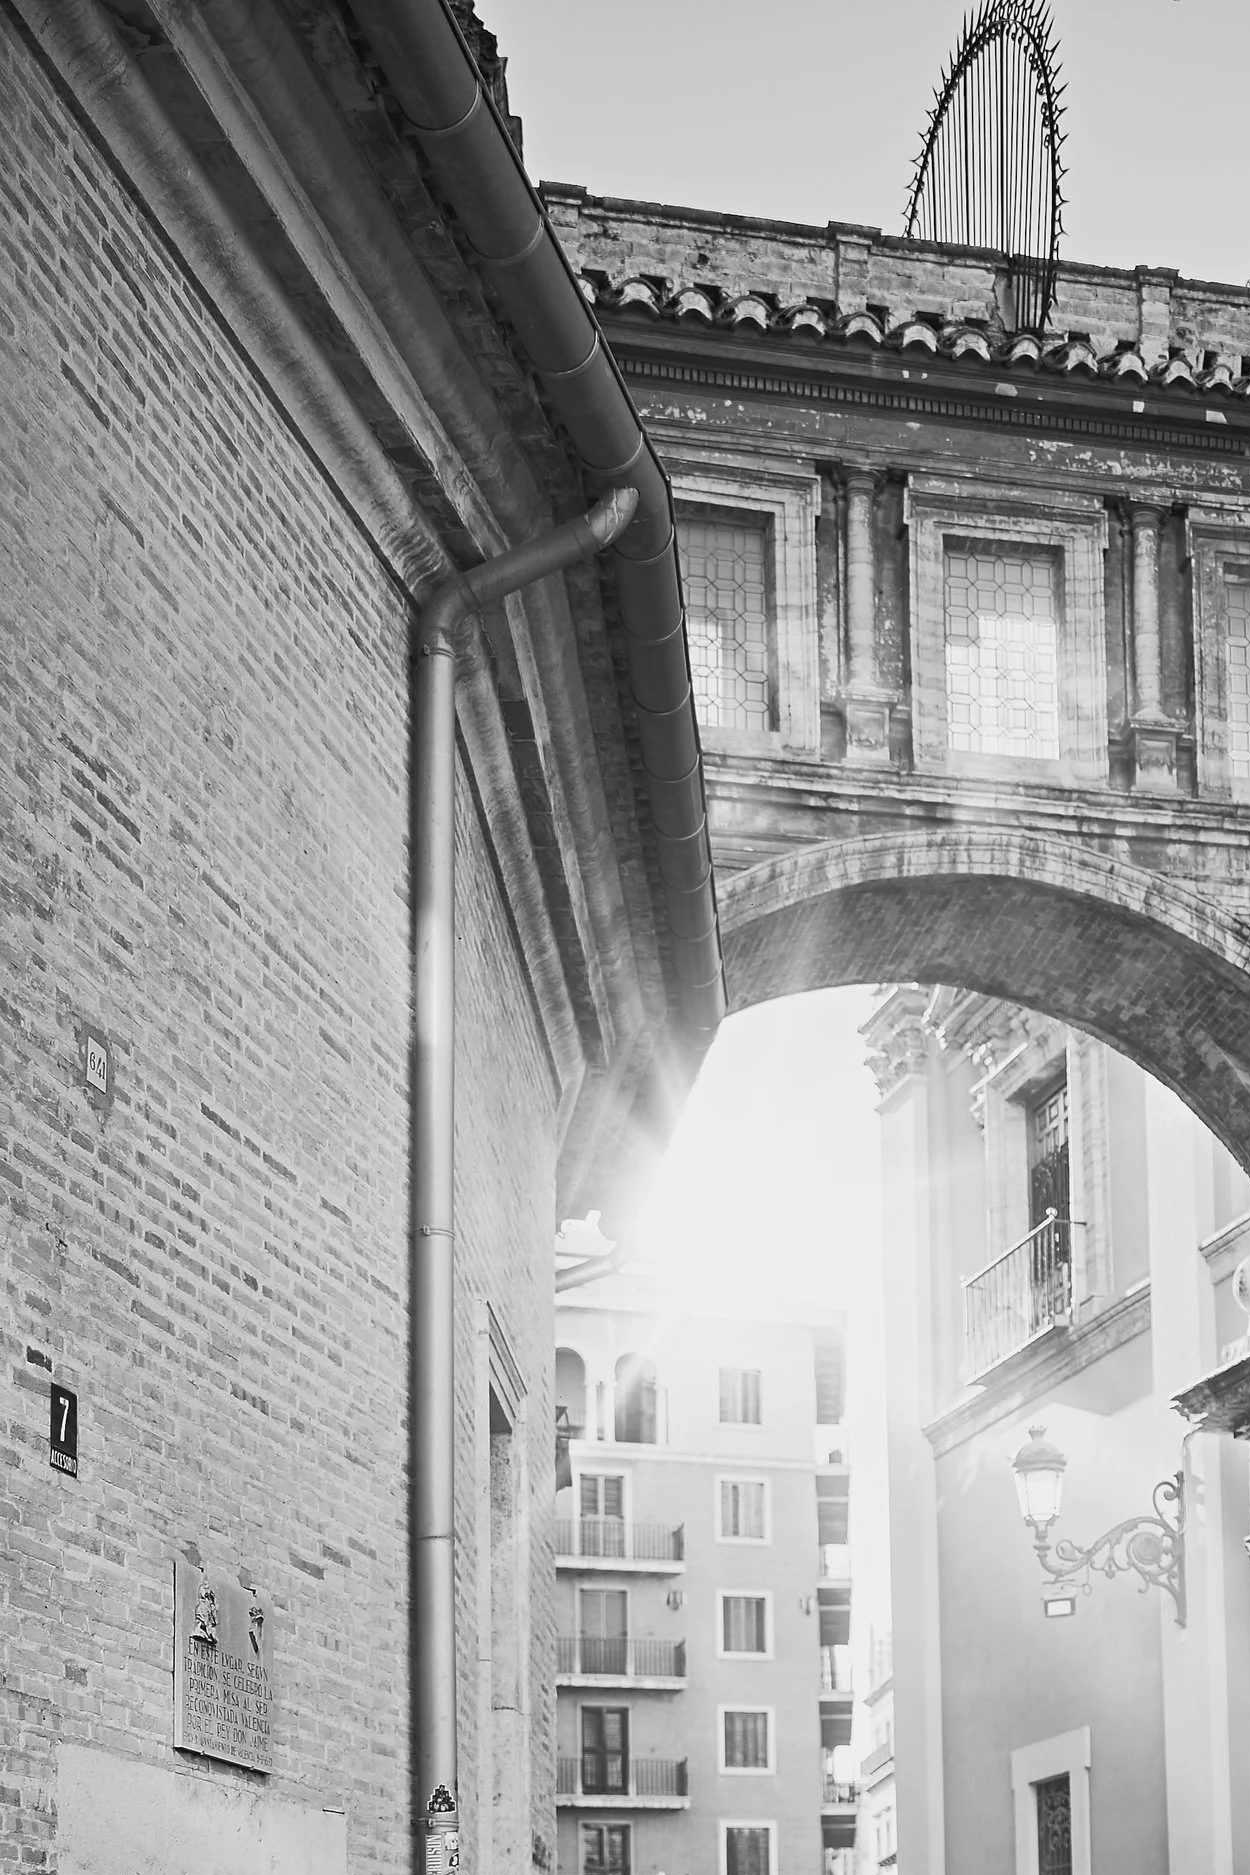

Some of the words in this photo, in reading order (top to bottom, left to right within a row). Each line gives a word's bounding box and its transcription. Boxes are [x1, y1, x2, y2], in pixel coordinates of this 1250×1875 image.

[60, 1396, 70, 1442] 7
[189, 1636, 199, 1656] EN
[201, 1644, 219, 1665] ESTE
[189, 1677, 219, 1701] PRIMERA
[223, 1689, 239, 1707] MISA
[243, 1697, 251, 1712] AL
[256, 1701, 267, 1717] SER
[222, 1671, 231, 1687] SE
[264, 1686, 273, 1701] LA
[187, 1712, 201, 1731] POR
[205, 1718, 213, 1735] EL
[217, 1722, 230, 1740] REY
[233, 1728, 246, 1745] DON
[241, 1713, 270, 1735] VALENCIA
